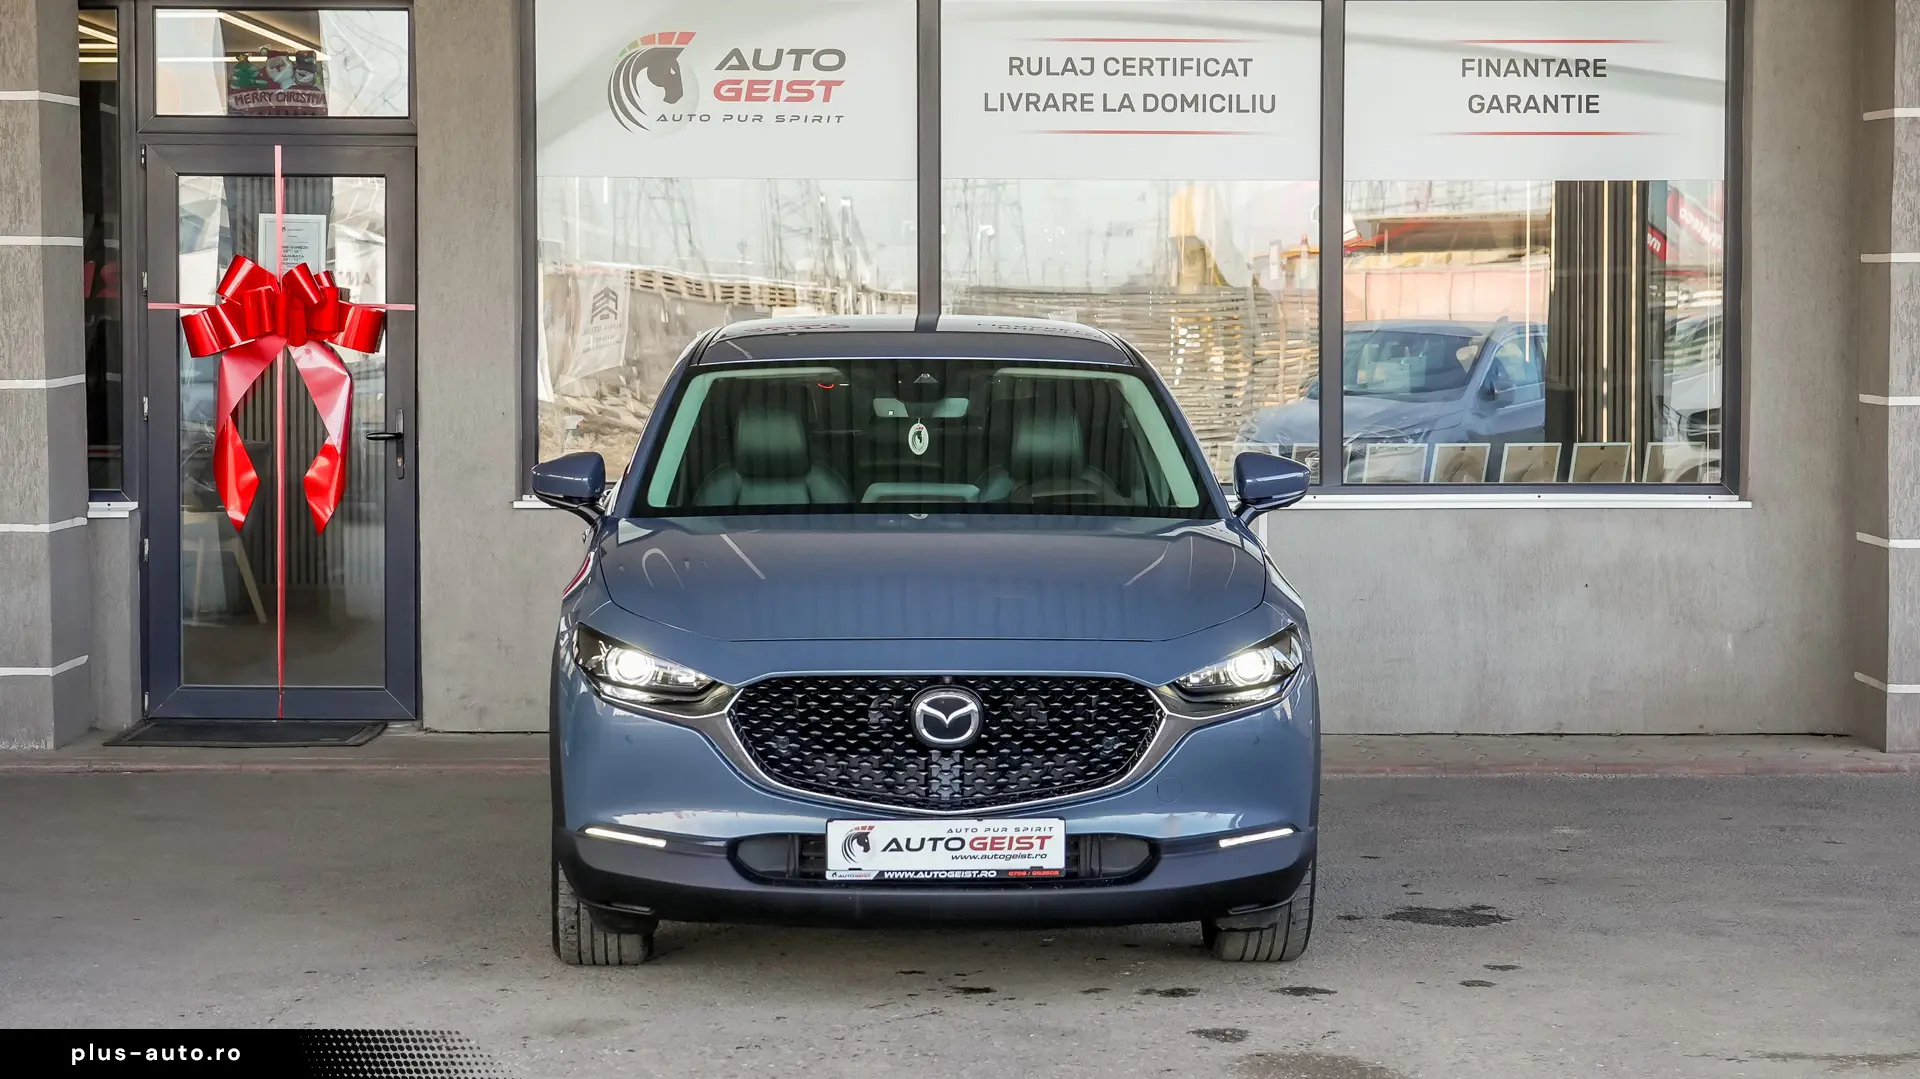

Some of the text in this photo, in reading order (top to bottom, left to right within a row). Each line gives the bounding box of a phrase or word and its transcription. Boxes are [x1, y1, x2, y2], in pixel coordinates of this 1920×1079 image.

[714, 48, 847, 72] AUTO
[1008, 56, 1254, 78] RULAJ CERTIFICAT
[1461, 58, 1607, 78] FINANTARE
[234, 91, 327, 106] MERRY CHRISTMA
[713, 79, 846, 103] GEIST
[983, 92, 1277, 114] LIVRARE LA DOMICILIU
[1467, 94, 1601, 114] GARANTIE
[656, 113, 845, 124] AUTO PUR SPIRIT
[880, 834, 1054, 852] AUTOGEIST
[951, 852, 1048, 861] www.autogeist.ro
[884, 870, 997, 879] WWW.AUTOGEIST.RO
